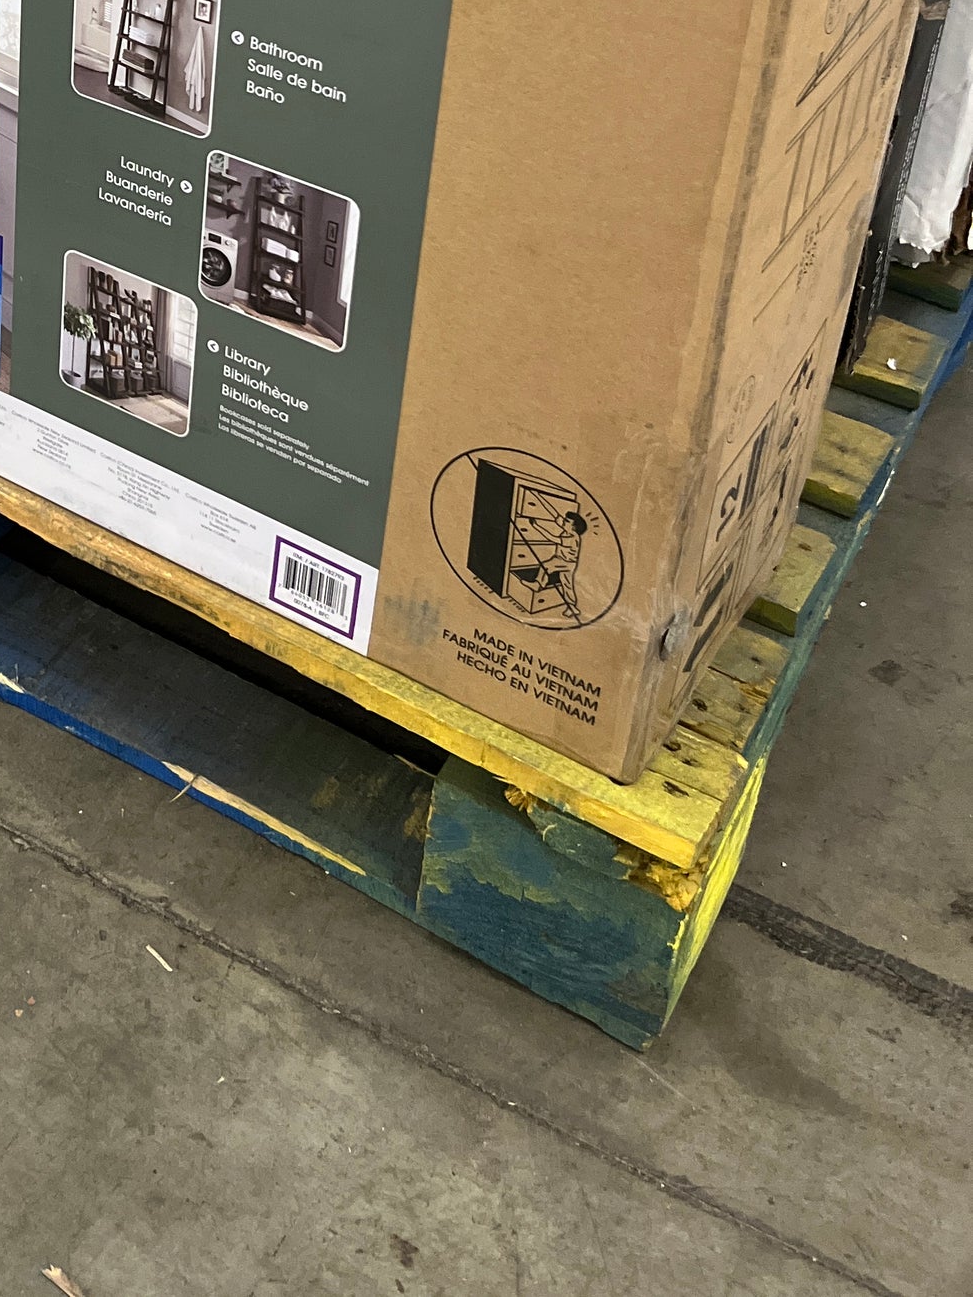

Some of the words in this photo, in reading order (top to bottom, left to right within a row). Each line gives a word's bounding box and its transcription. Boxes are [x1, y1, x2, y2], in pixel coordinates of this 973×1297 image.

[249, 35, 324, 72] Bathroom
[246, 80, 286, 105] Baño
[247, 57, 284, 82] Salle
[286, 69, 308, 90] de
[311, 77, 347, 103] bain
[105, 170, 174, 207] Buanderie
[120, 155, 175, 189] Laundry
[98, 187, 172, 227] Lavandería
[224, 345, 271, 376] Library
[221, 383, 289, 424] Biblioteca
[222, 364, 309, 412] Bibliothèque
[219, 404, 257, 426] Bookcases
[257, 421, 272, 434] sold
[273, 428, 310, 451] separately
[442, 628, 509, 668] FABRIQUÉ
[511, 663, 532, 679] AU
[535, 671, 599, 712] VIETNAM
[473, 628, 515, 657] MADE
[519, 649, 533, 665] IN
[537, 657, 602, 698] VIETNAM
[456, 651, 507, 683] HECHO
[510, 678, 529, 694] EN
[533, 686, 596, 726] VIETNAM
